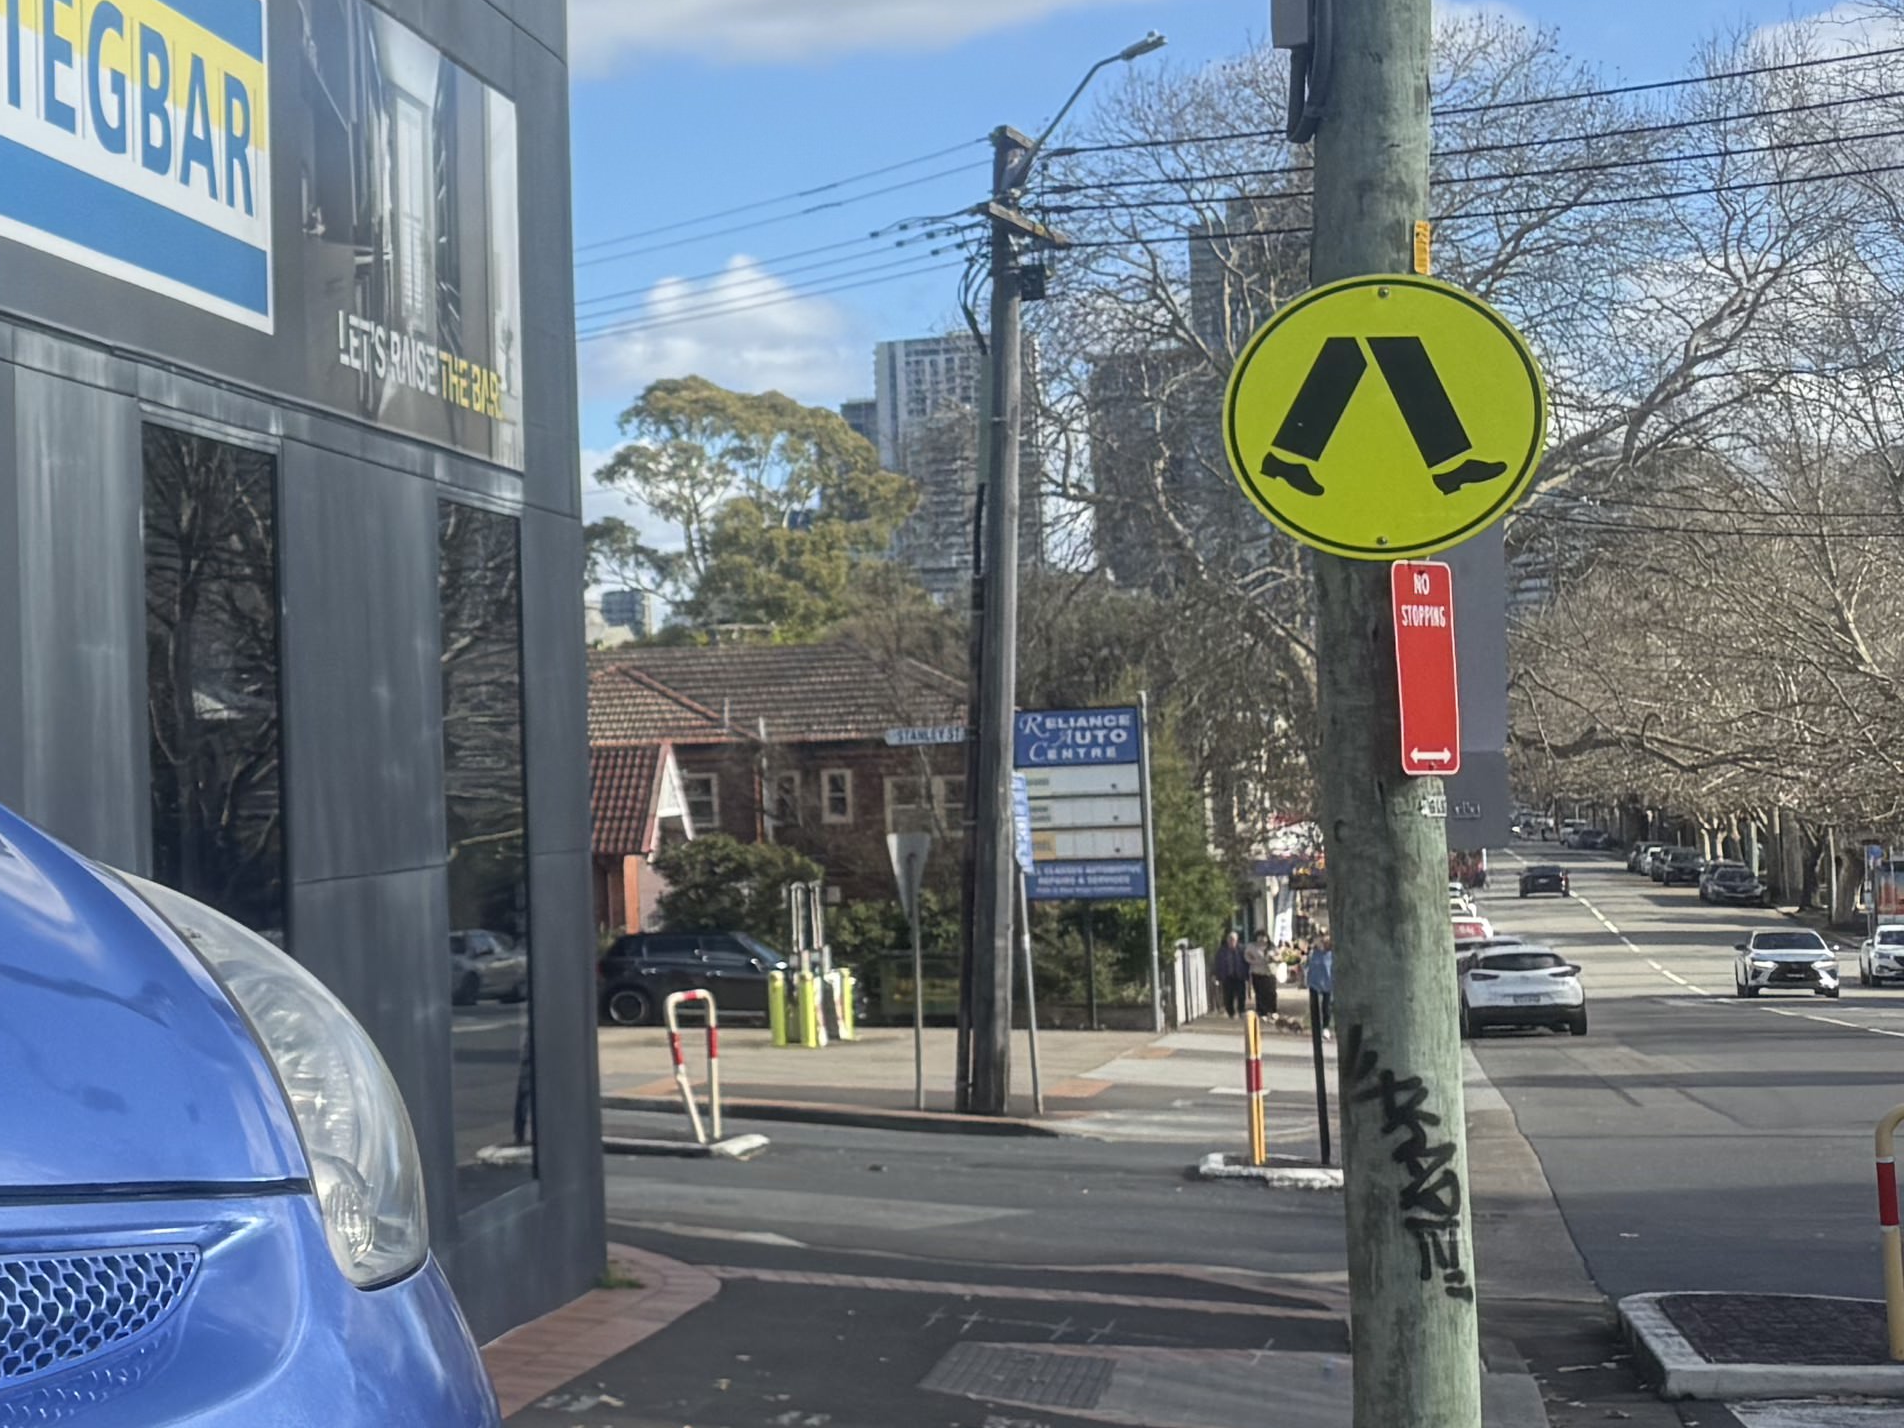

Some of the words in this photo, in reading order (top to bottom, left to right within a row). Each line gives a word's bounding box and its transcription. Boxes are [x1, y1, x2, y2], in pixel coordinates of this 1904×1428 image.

[338, 309, 387, 379] LET'S
[390, 331, 438, 396] RAISE
[438, 350, 470, 409] THE
[1413, 572, 1430, 595] NO
[1401, 604, 1446, 628] STOPPING
[1018, 713, 1131, 738] RELIANCE
[1052, 728, 1128, 747] AUTO
[1029, 741, 1117, 762] CENTRE
